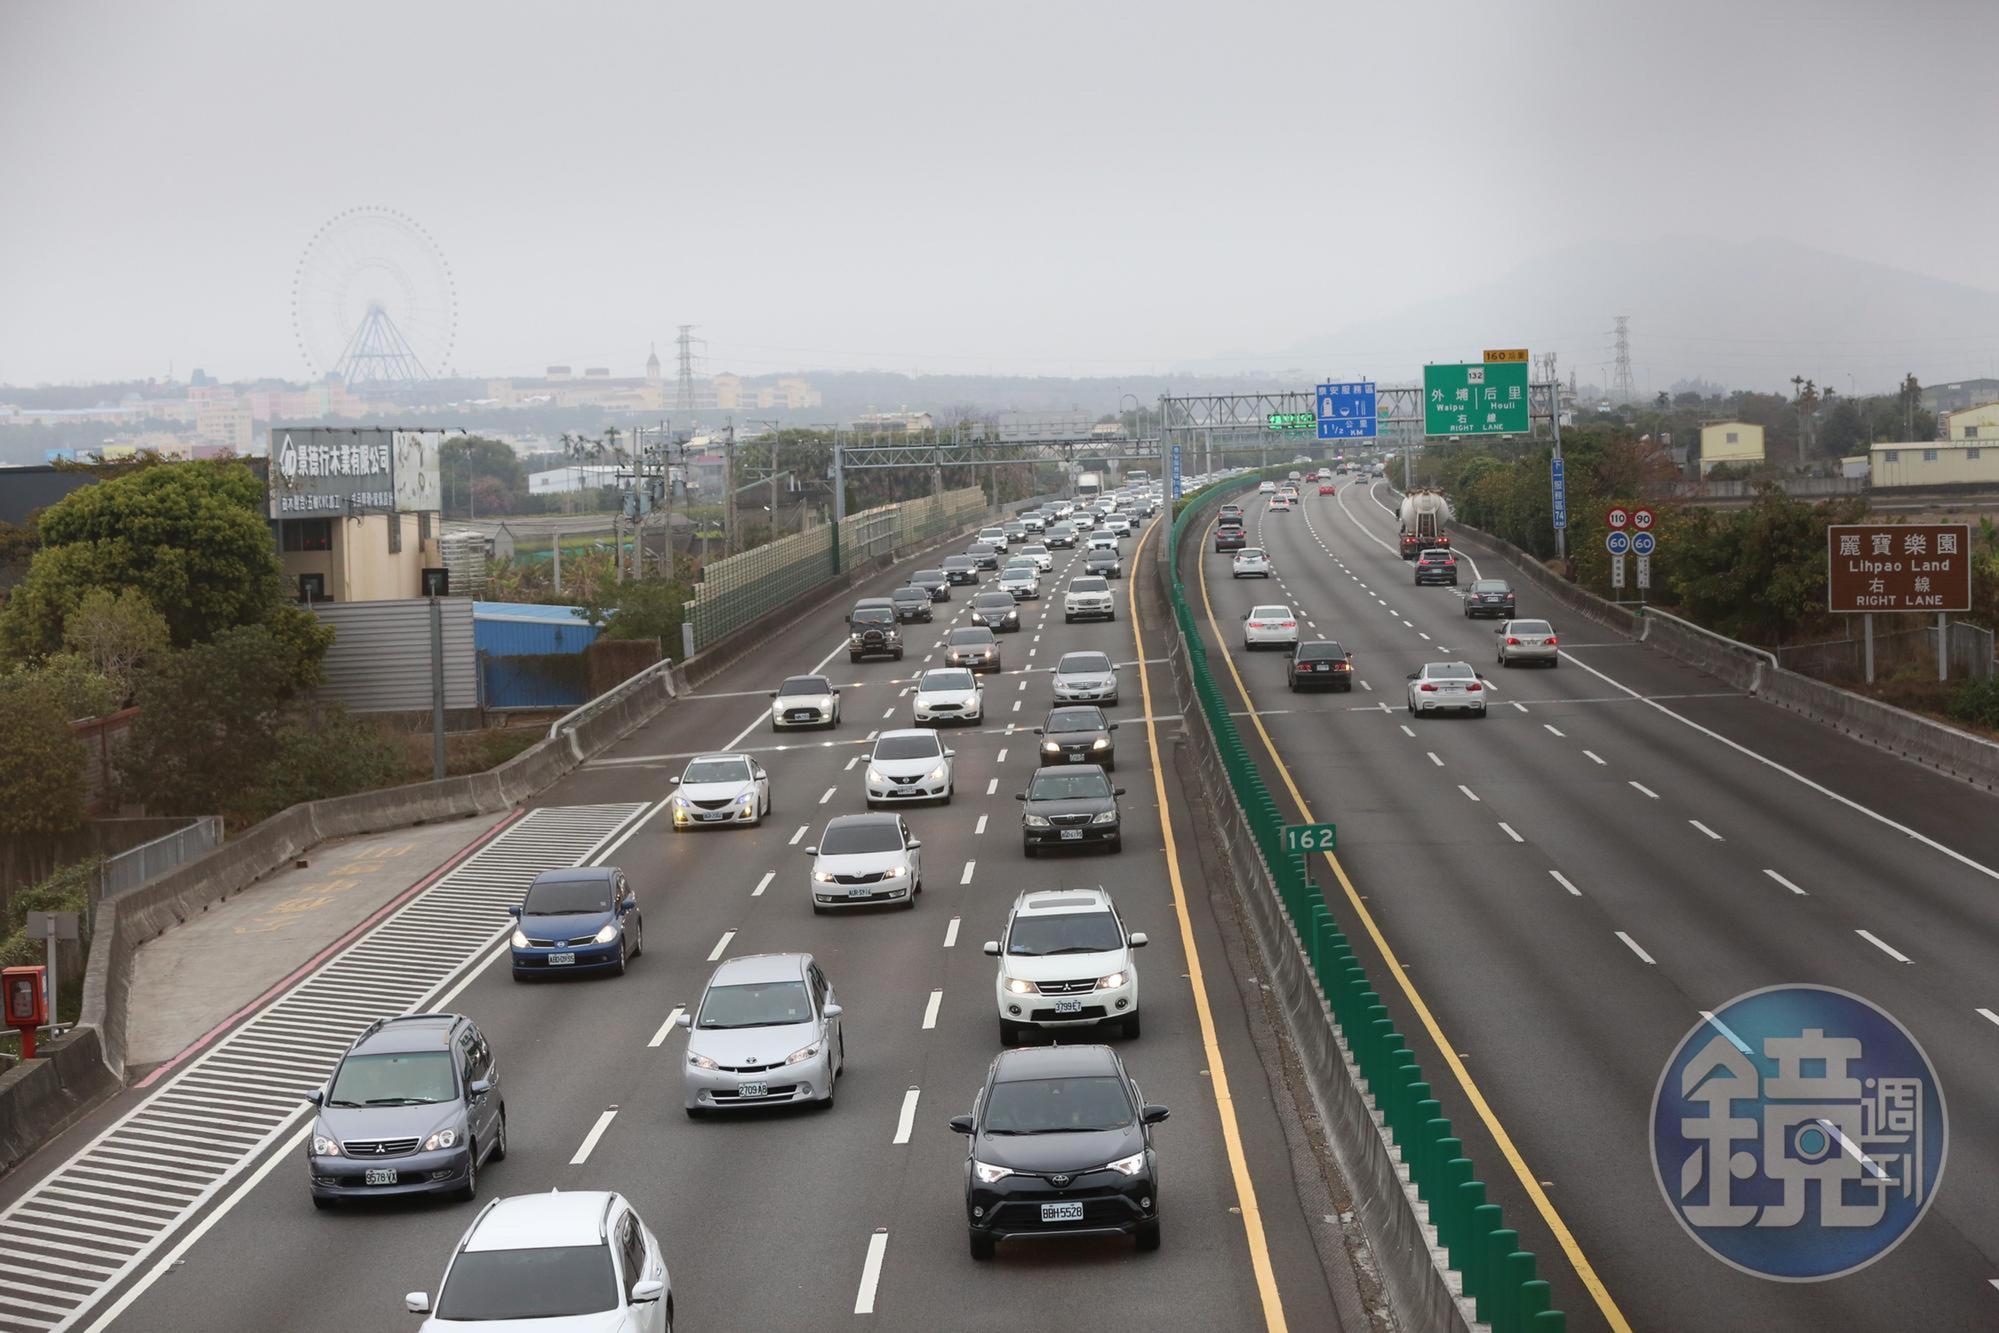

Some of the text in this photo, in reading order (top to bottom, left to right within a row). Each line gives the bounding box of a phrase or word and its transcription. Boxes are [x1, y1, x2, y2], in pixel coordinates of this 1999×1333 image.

[1432, 386, 1522, 402] 外埔 后里
[1436, 402, 1515, 412] Waipu Houli
[1555, 511, 1564, 520] 74
[1611, 514, 1625, 523] 110
[1636, 515, 1650, 524] 90
[1610, 538, 1626, 548] 60
[1635, 539, 1651, 548] 60
[1840, 533, 1957, 556] 麗寶樂園
[1850, 560, 1950, 574] Lihpao Land
[1868, 576, 1930, 593] 右線
[1856, 595, 1943, 606] RIGHT LANE
[1290, 829, 1334, 849] 162
